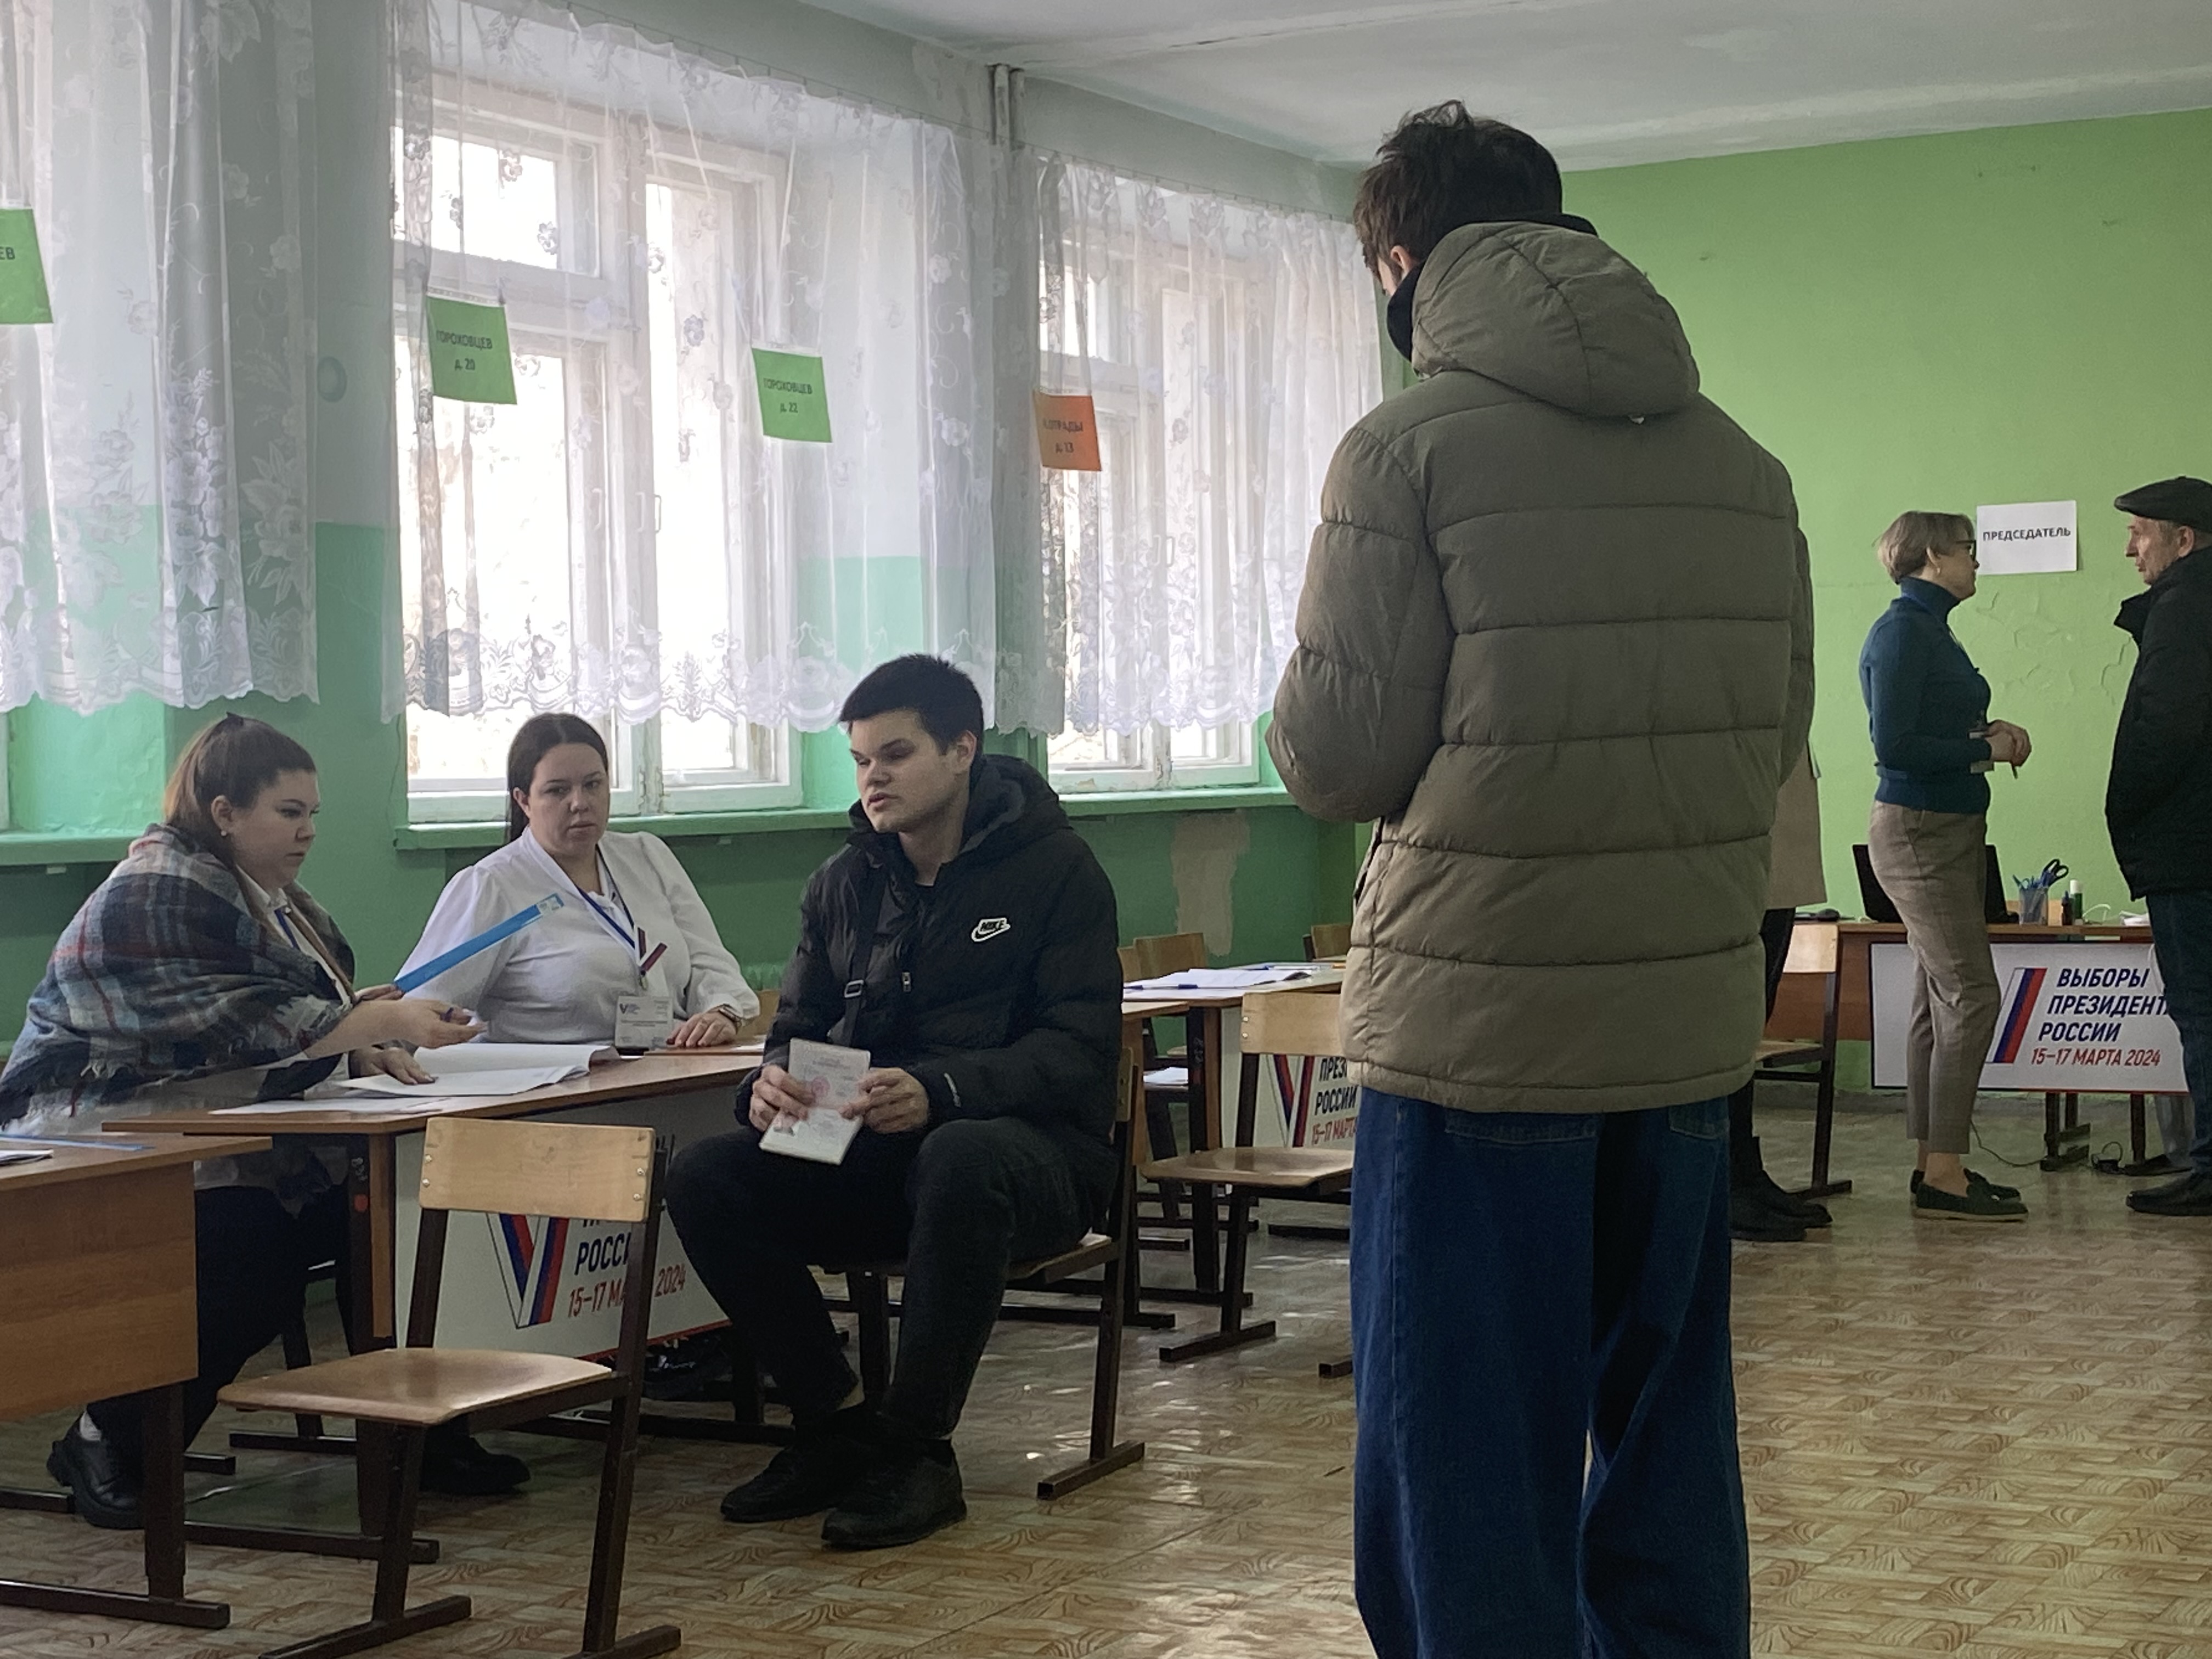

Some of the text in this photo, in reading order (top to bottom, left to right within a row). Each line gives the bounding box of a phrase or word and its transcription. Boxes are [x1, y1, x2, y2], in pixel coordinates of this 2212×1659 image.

[465, 358, 475, 371] 20
[789, 402, 798, 413] 22
[1983, 527, 2071, 541] ПРЕДСЕДАТЕЛЬ
[2057, 968, 2149, 988] ВЫБОРЫ
[2047, 995, 2168, 1018] ПРЕЗИДЕНТ
[2038, 1023, 2121, 1042] РОССИИ
[2073, 1049, 2121, 1066] МАРТА
[2124, 1049, 2161, 1066] 2024
[1315, 1085, 1357, 1115] РОССИИ
[654, 1263, 686, 1297] 2024
